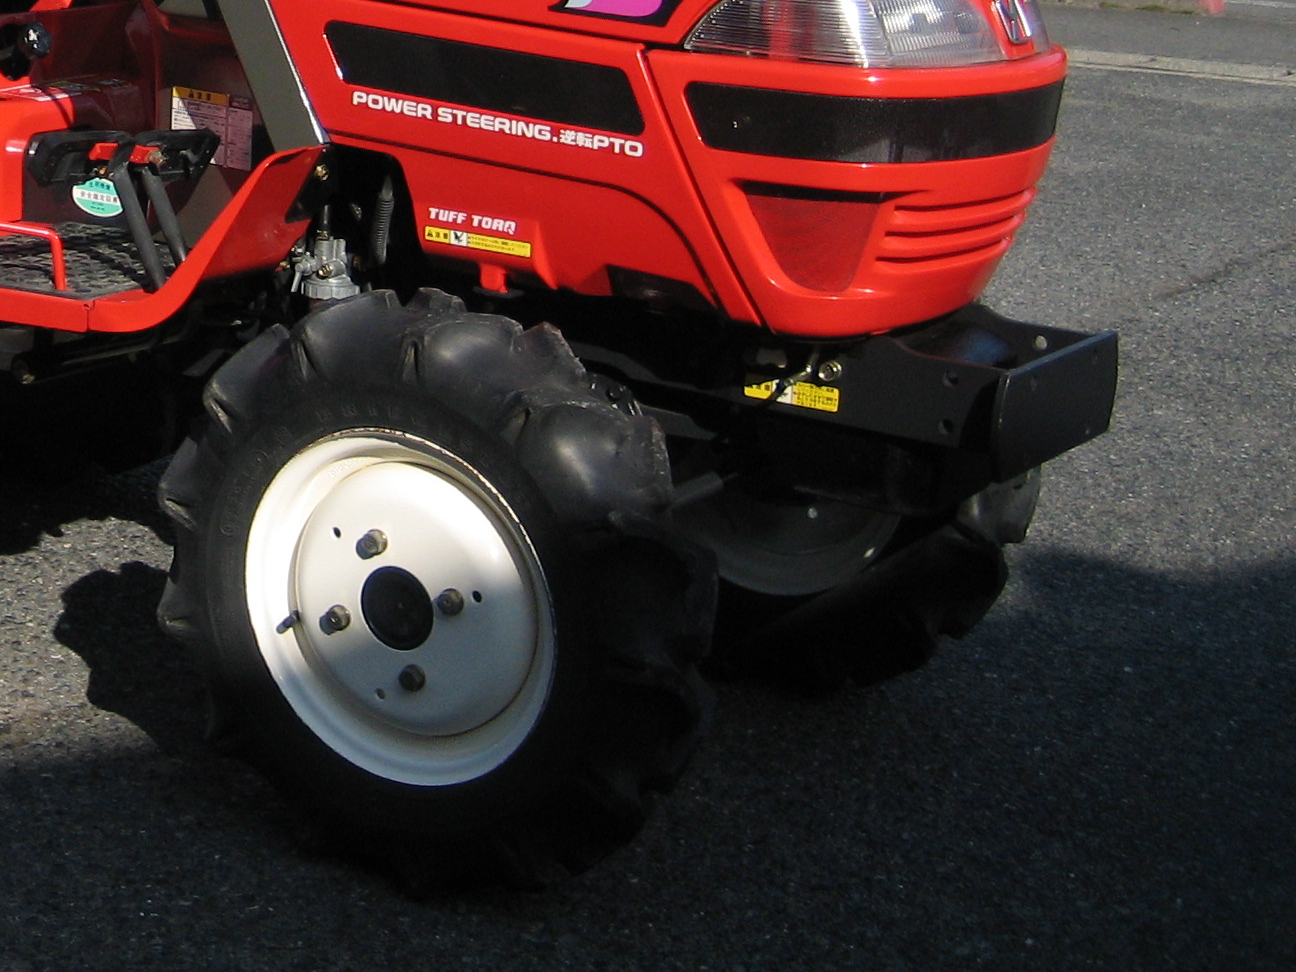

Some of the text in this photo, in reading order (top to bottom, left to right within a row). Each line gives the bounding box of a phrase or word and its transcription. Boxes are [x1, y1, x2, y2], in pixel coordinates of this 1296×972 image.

[352, 91, 433, 120] POWER
[428, 207, 517, 235] TUFF TORQ
